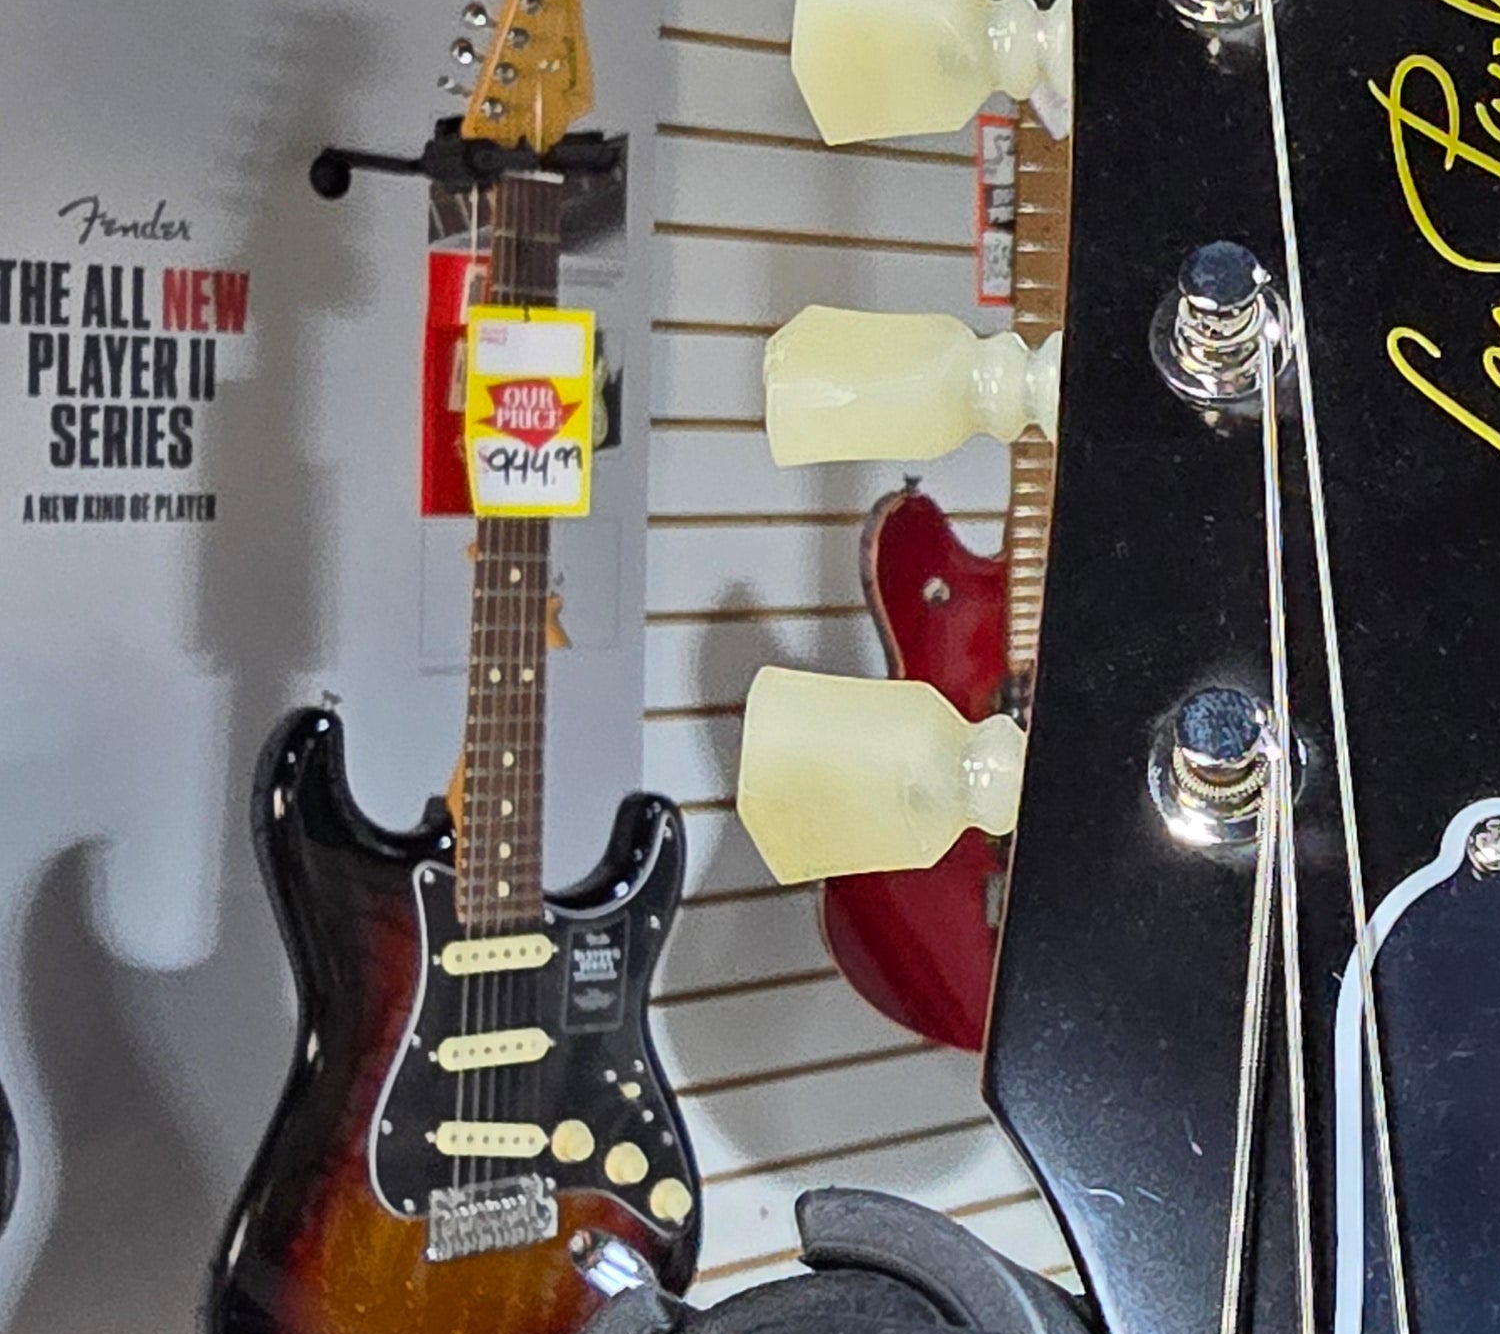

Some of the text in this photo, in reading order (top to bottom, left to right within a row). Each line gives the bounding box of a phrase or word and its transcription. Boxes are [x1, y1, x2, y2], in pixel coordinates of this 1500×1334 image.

[58, 195, 192, 245] Fender
[0, 259, 249, 334] THE ALL NEW
[28, 332, 216, 401] PLAYER II
[496, 408, 563, 431] PRICE
[502, 386, 554, 409] OUR
[50, 404, 193, 468] SERIES
[23, 494, 33, 524] A
[39, 494, 79, 523] NEW
[154, 493, 216, 523] PLAYER
